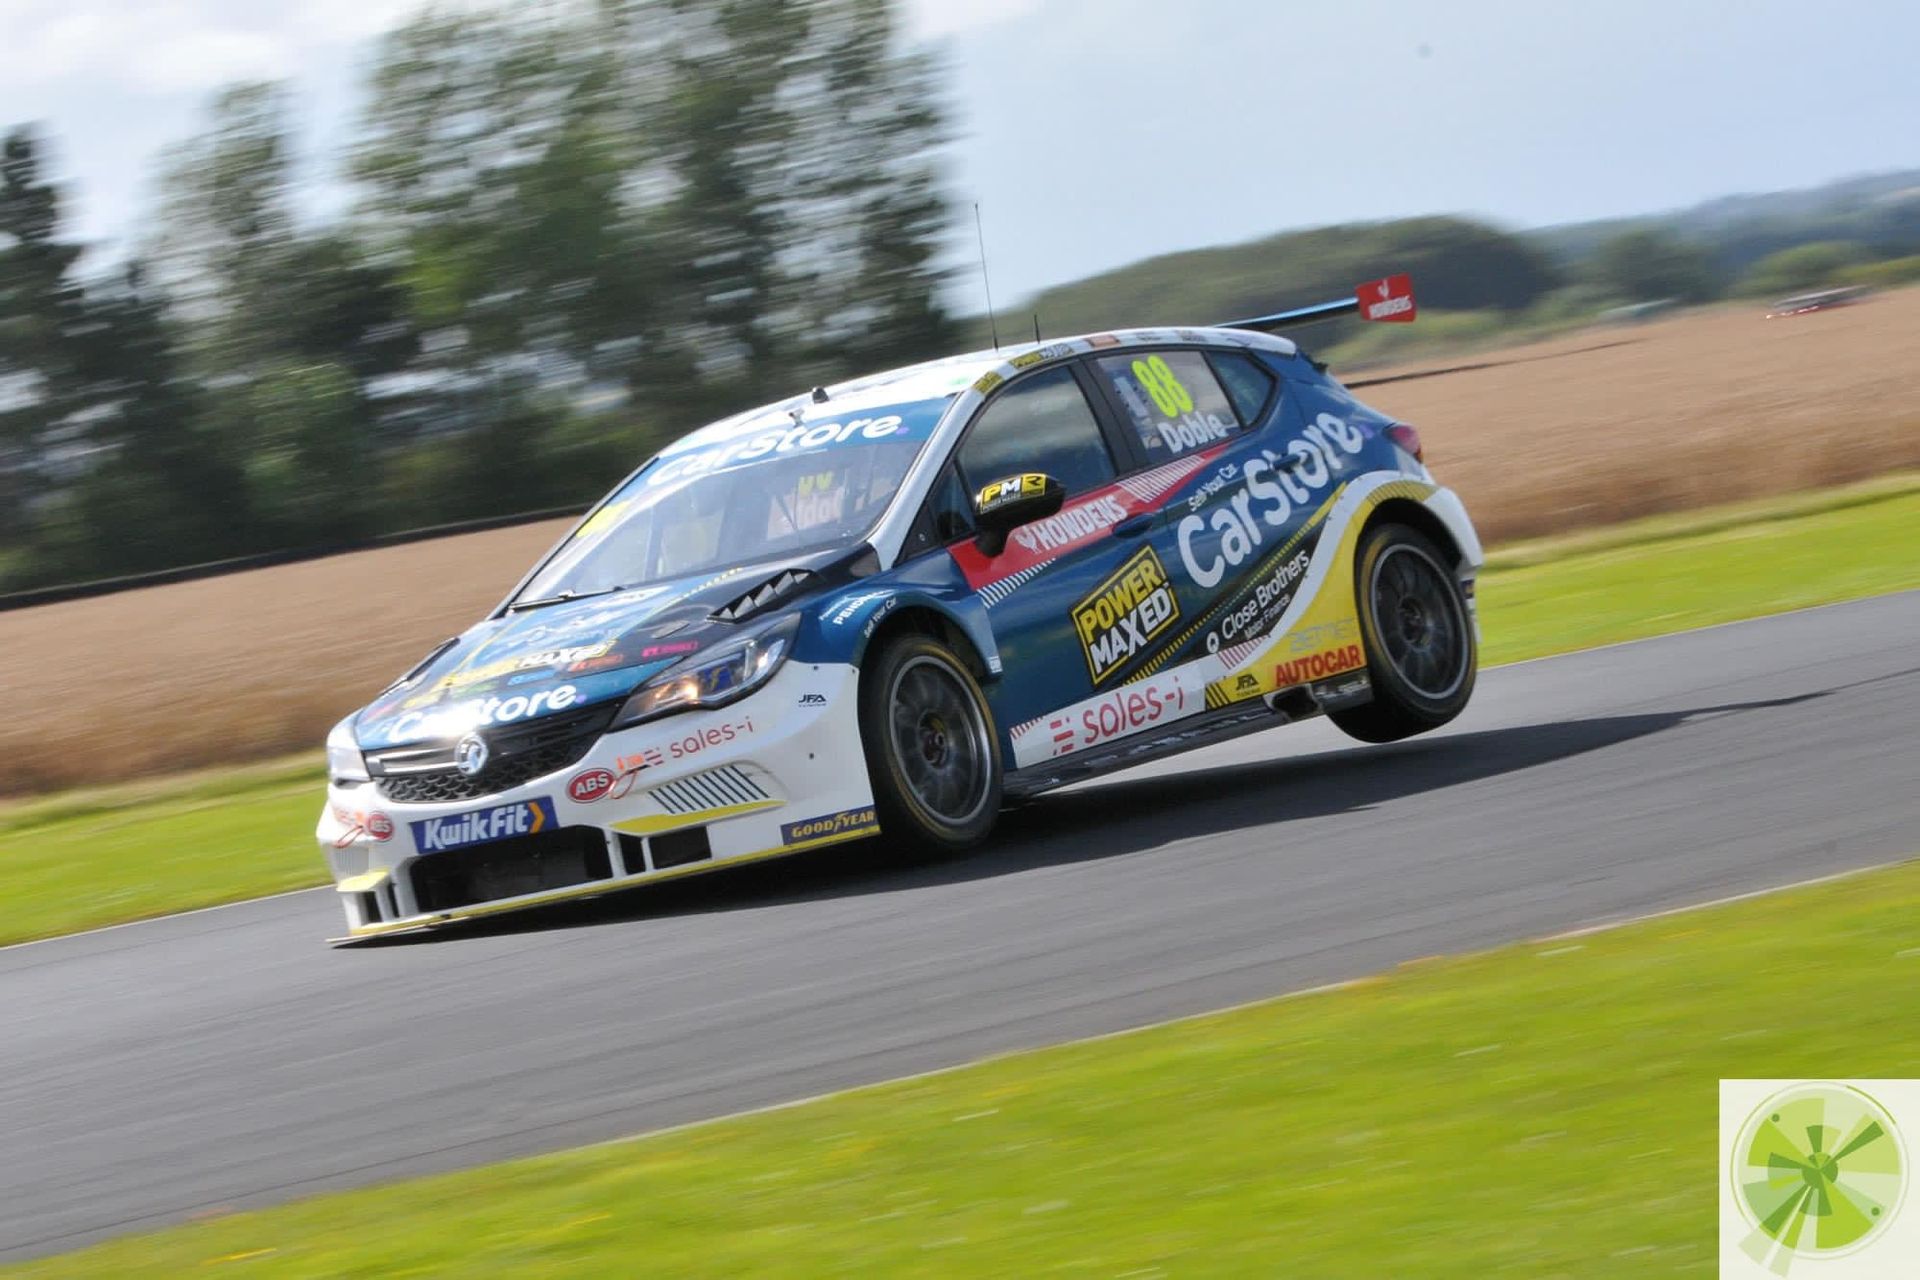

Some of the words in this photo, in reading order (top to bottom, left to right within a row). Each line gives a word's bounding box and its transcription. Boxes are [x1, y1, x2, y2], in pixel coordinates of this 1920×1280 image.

[1132, 355, 1193, 417] 88
[1156, 411, 1229, 454] Doble
[984, 475, 1043, 503] PMR
[1178, 413, 1363, 588] CarStore
[1189, 489, 1207, 512] Sell
[1201, 475, 1225, 495] Your
[1033, 494, 1128, 550] HOWDENS
[1079, 559, 1162, 644] POWER
[1222, 599, 1258, 639] Close
[1256, 550, 1309, 608] Brothers
[1090, 587, 1171, 674] MAXED
[1276, 645, 1361, 688] AUTOCAR
[798, 693, 827, 704] JFA
[1083, 677, 1184, 744] sales-i
[670, 715, 754, 759] sales-i
[575, 773, 609, 797] ABS
[791, 810, 875, 838] GOODYEAR
